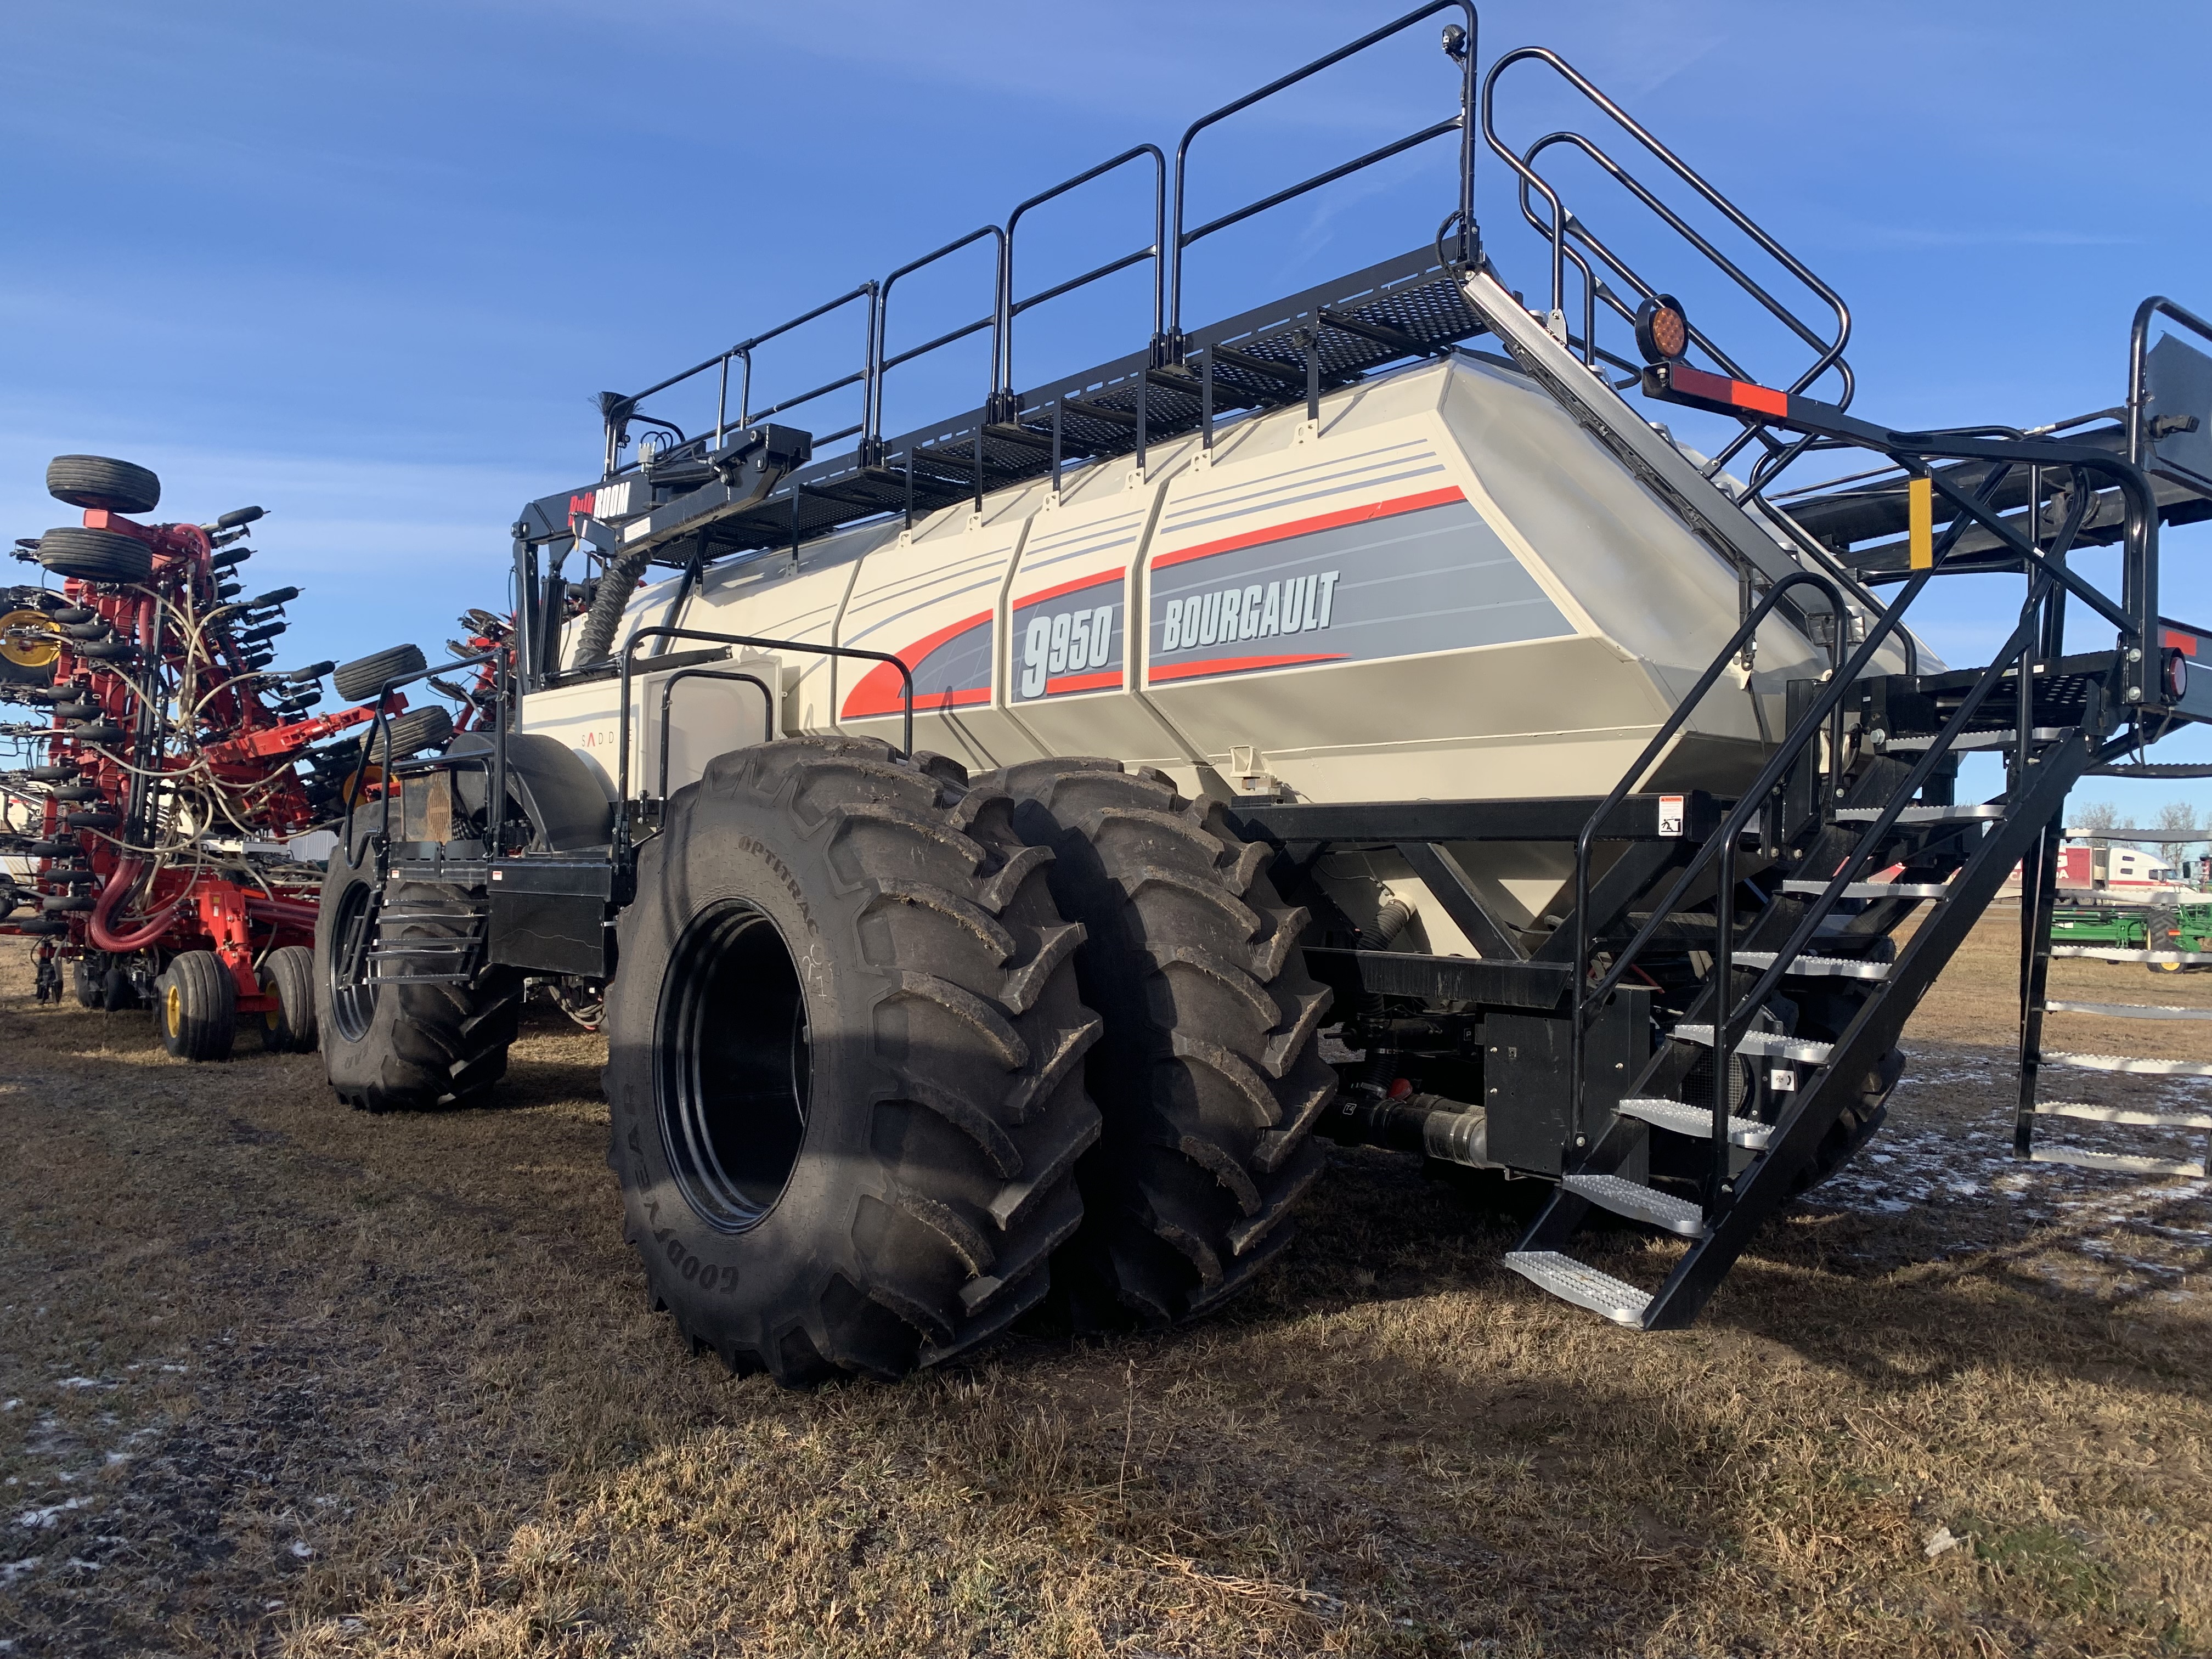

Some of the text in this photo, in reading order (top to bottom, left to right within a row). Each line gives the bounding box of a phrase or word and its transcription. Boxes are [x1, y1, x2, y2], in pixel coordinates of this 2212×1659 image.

[1022, 606, 1113, 698] 9950
[1163, 571, 1340, 652] BOURGAULT
[582, 729, 632, 747] SADDE
[738, 836, 819, 938] OPTITRAC
[623, 1083, 739, 1294] GOODYEAR
